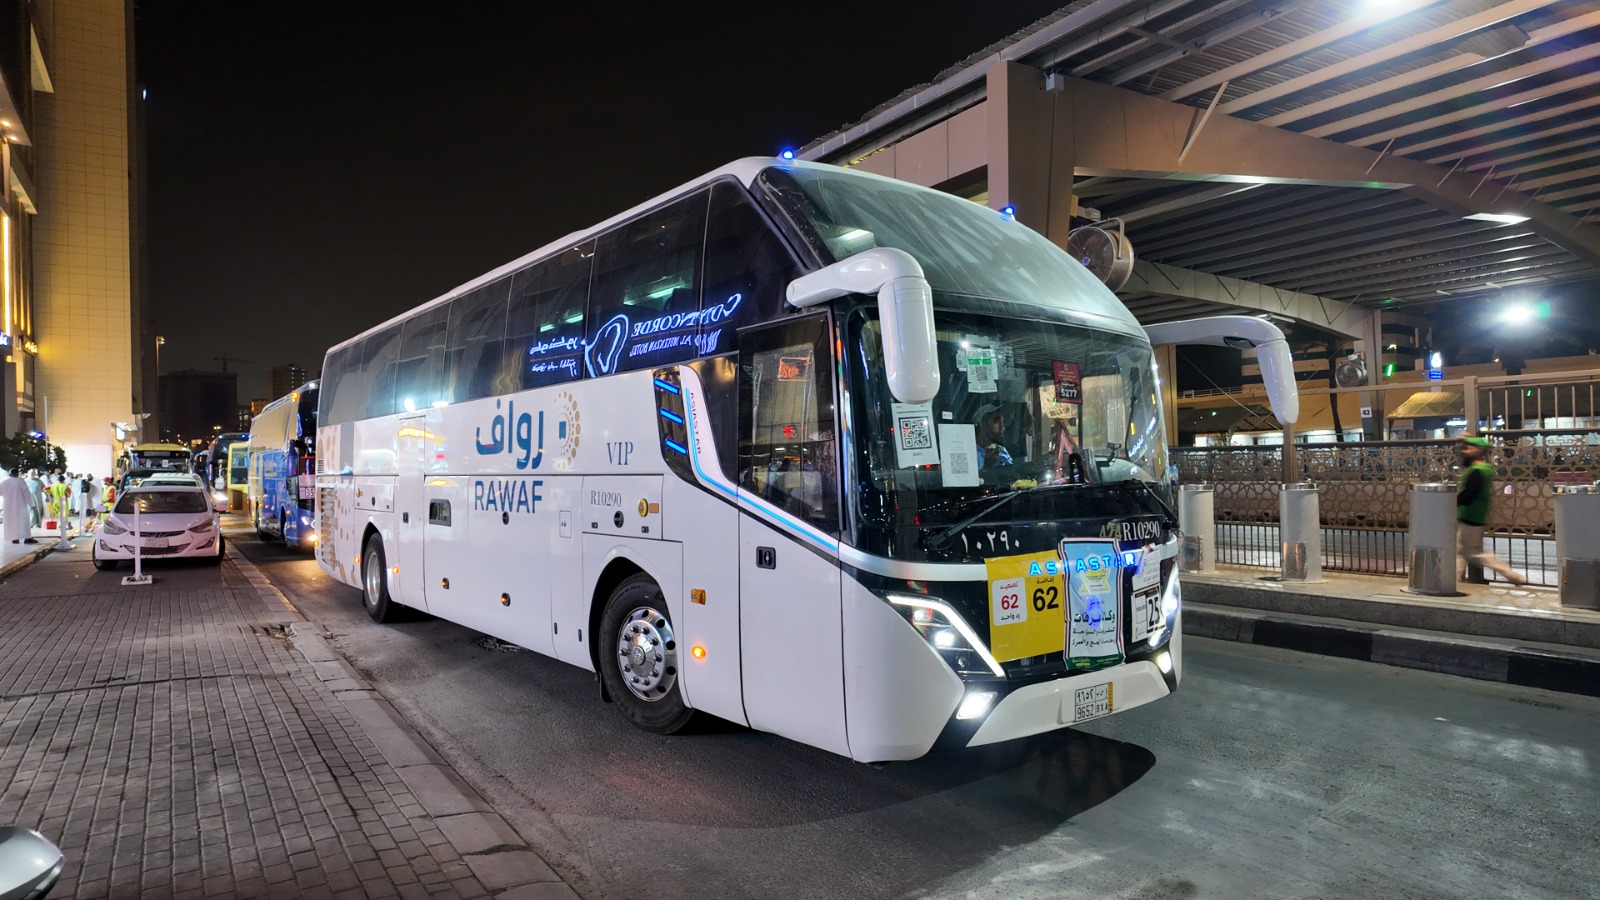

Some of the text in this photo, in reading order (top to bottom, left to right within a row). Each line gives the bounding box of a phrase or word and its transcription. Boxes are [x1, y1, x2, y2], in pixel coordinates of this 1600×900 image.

[476, 398, 544, 470] رواف
[607, 441, 634, 466] VIP
[306, 488, 315, 497] 35
[474, 480, 544, 514] RAWAF
[590, 490, 622, 507] R10290
[1121, 521, 1160, 541] R10290
[1001, 593, 1019, 611] 62
[1032, 585, 1060, 612] 62
[1148, 596, 1160, 627] 25
[1077, 703, 1095, 719] 9652
